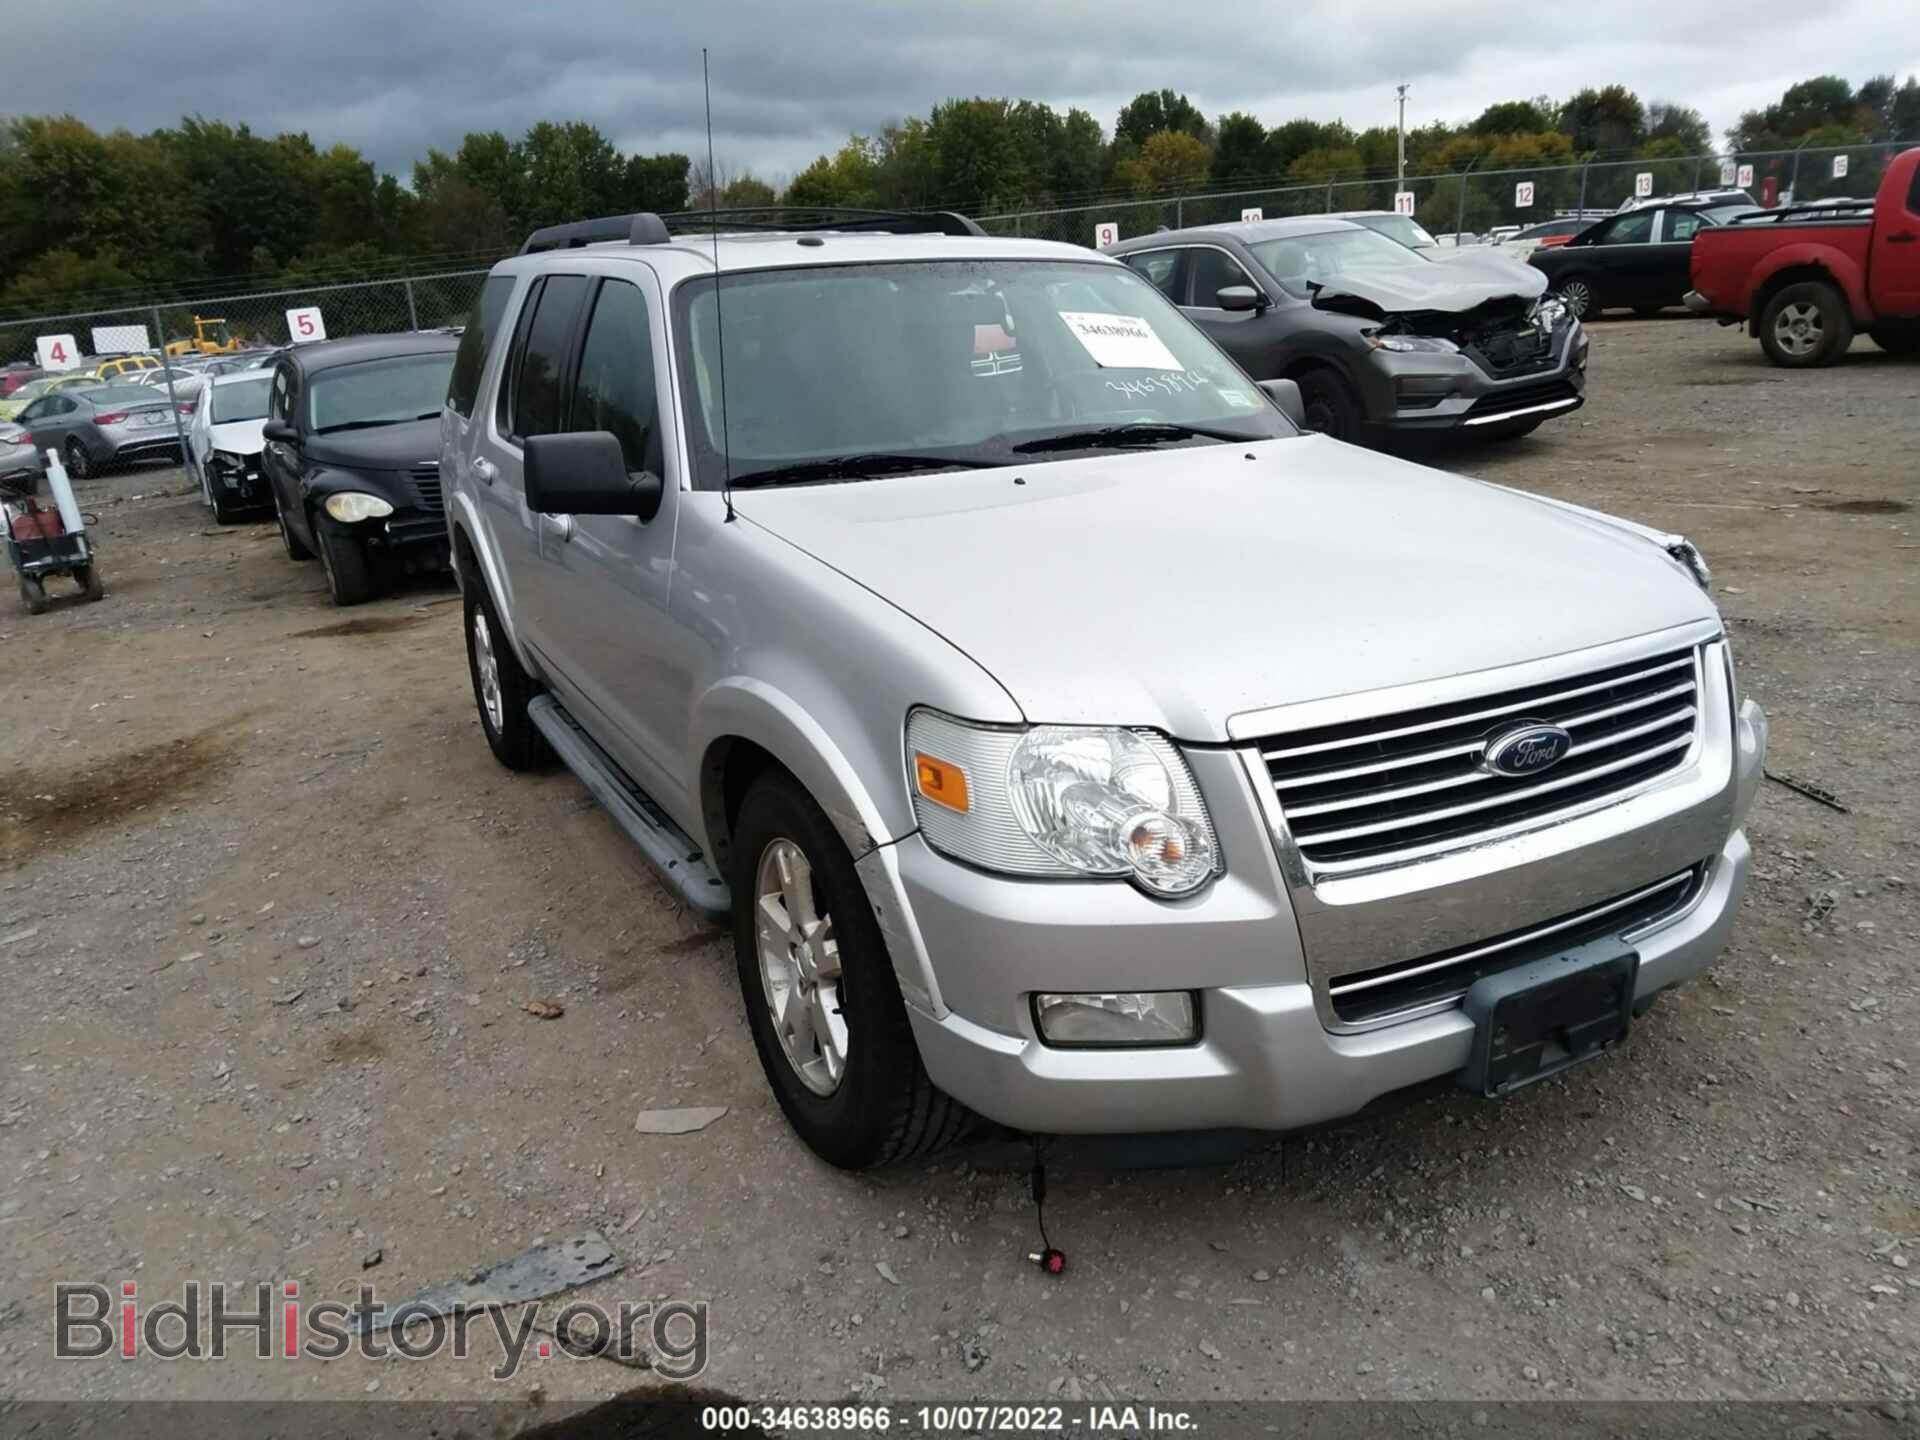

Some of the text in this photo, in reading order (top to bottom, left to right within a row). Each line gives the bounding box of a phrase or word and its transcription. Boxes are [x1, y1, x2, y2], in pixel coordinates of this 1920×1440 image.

[1637, 176, 1650, 193] 13
[1518, 186, 1532, 203] 12
[1397, 196, 1413, 213] 11
[1101, 228, 1112, 246] 9
[297, 314, 315, 336] 5
[1076, 323, 1149, 339] 34638966
[50, 342, 67, 363] 4
[1513, 735, 1560, 768] Ford
